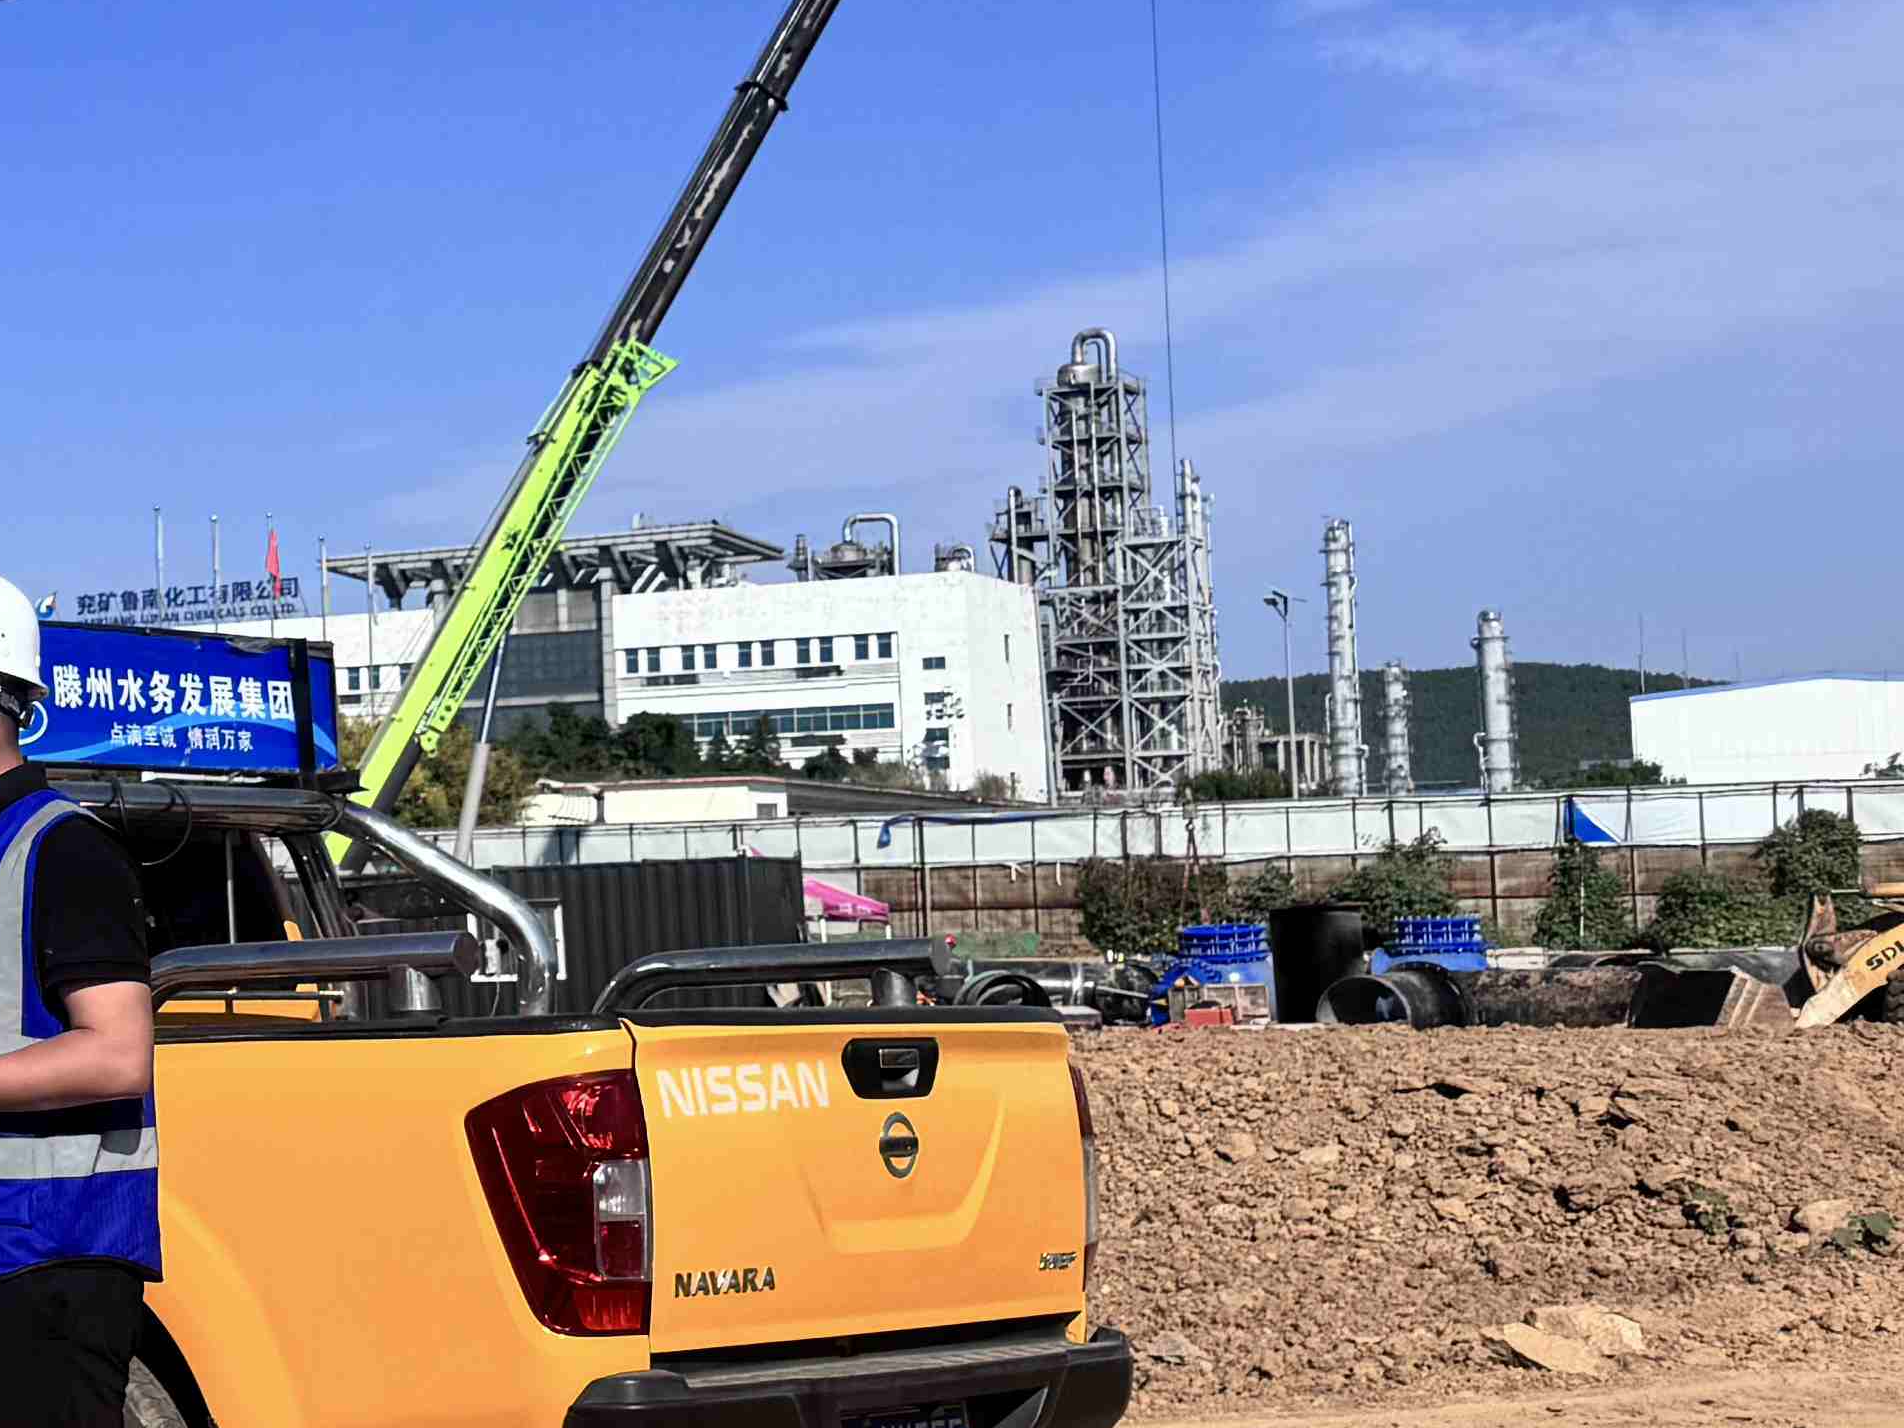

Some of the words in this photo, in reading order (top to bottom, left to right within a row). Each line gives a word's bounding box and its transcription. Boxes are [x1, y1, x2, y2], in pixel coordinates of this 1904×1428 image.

[52, 664, 295, 721] 滕州水务发展集团
[656, 1059, 830, 1118] NISSAN
[674, 1266, 776, 1298] NAVARA
